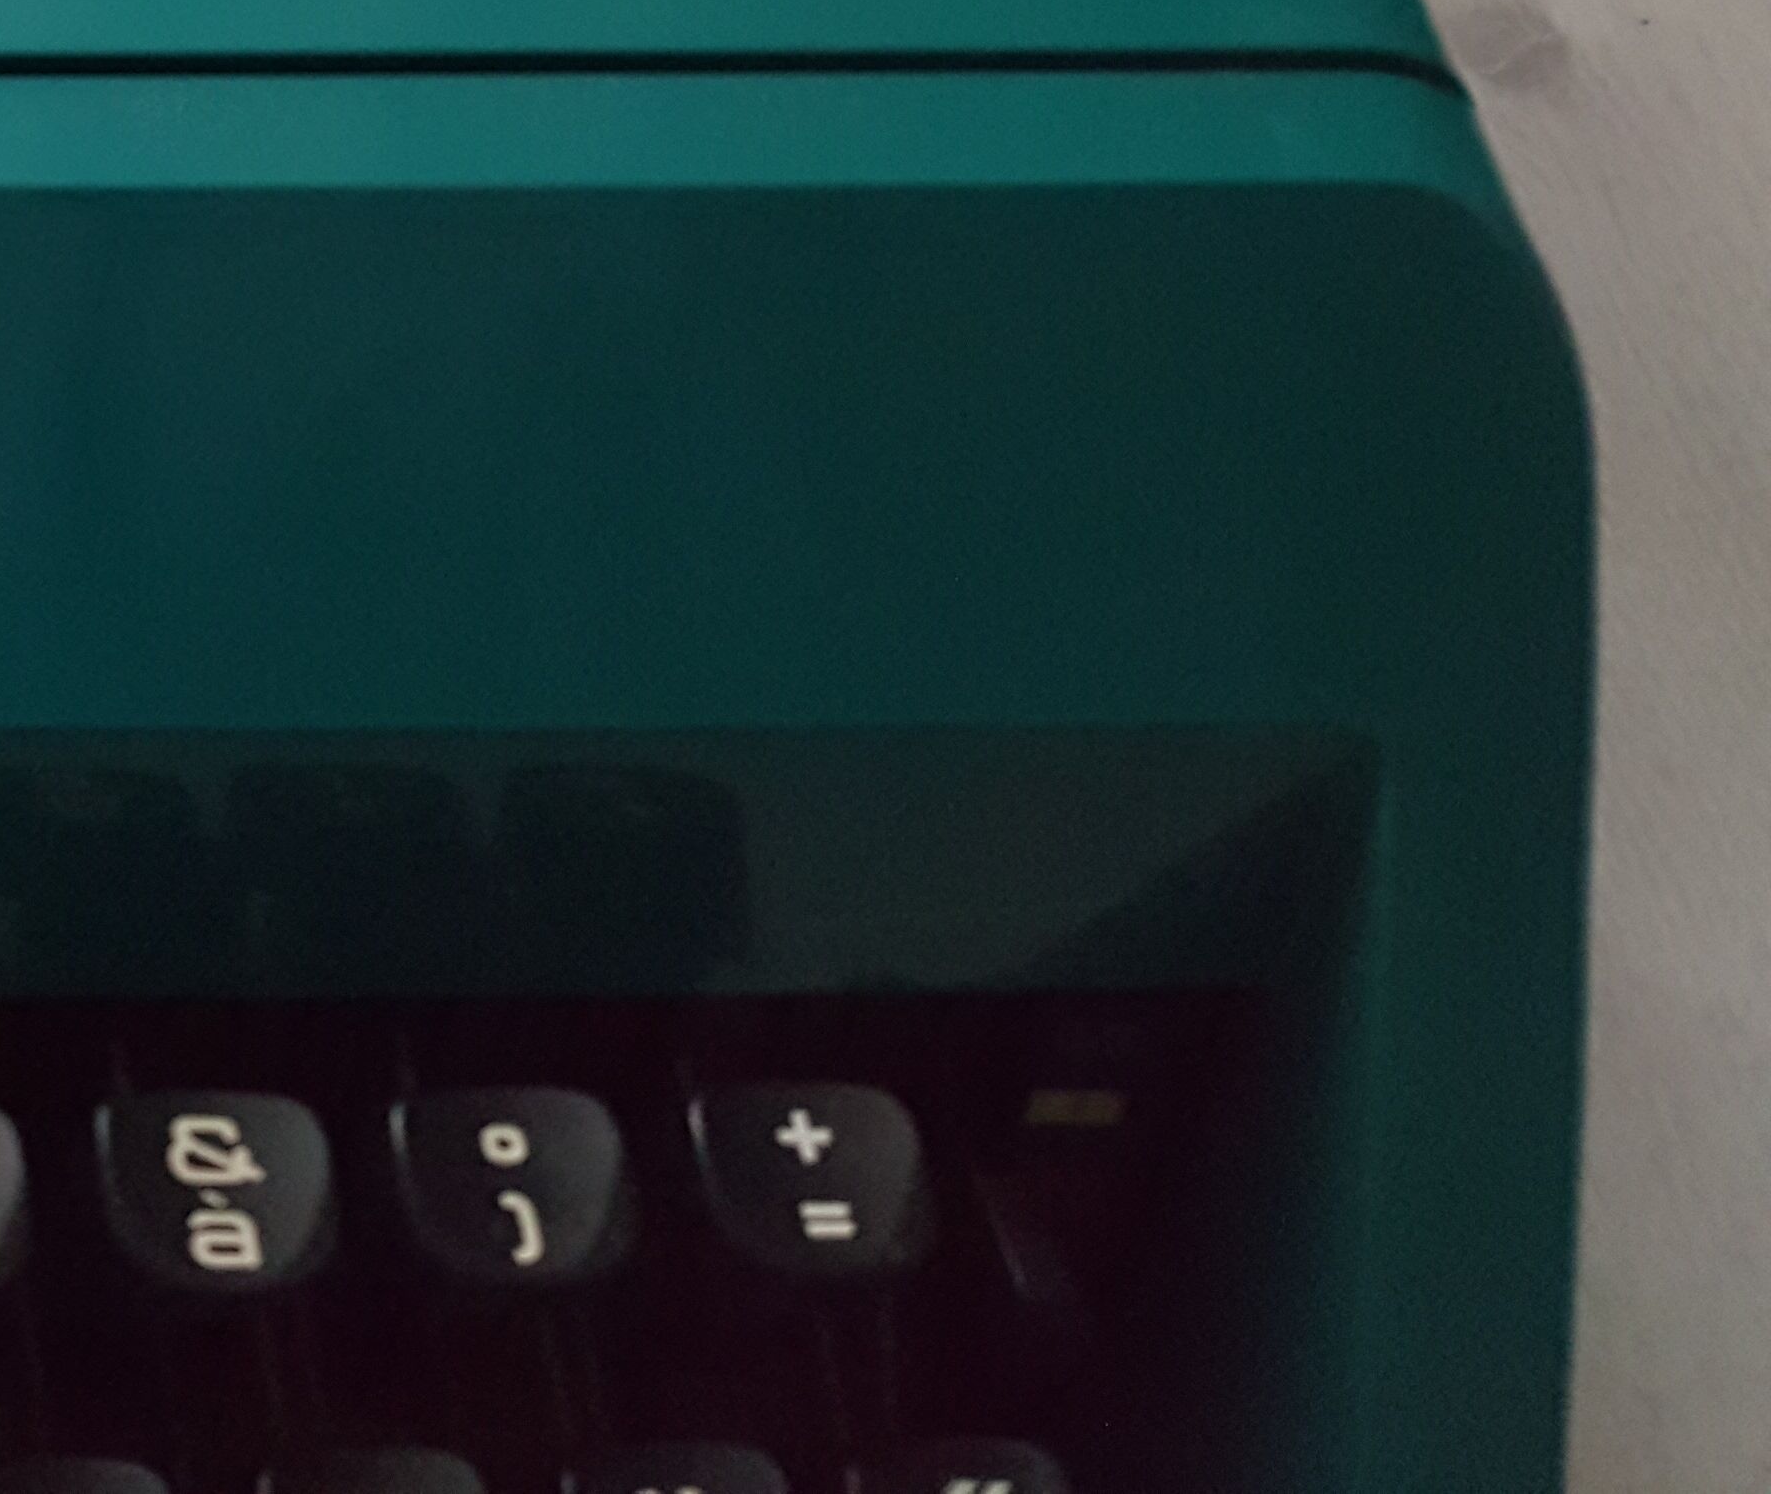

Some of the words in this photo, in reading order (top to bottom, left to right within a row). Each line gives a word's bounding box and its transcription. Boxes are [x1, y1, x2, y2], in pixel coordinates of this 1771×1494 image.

[169, 1118, 263, 1184] &
[776, 1108, 833, 1165] +
[190, 1194, 262, 1268] à
[798, 1201, 856, 1239] =
